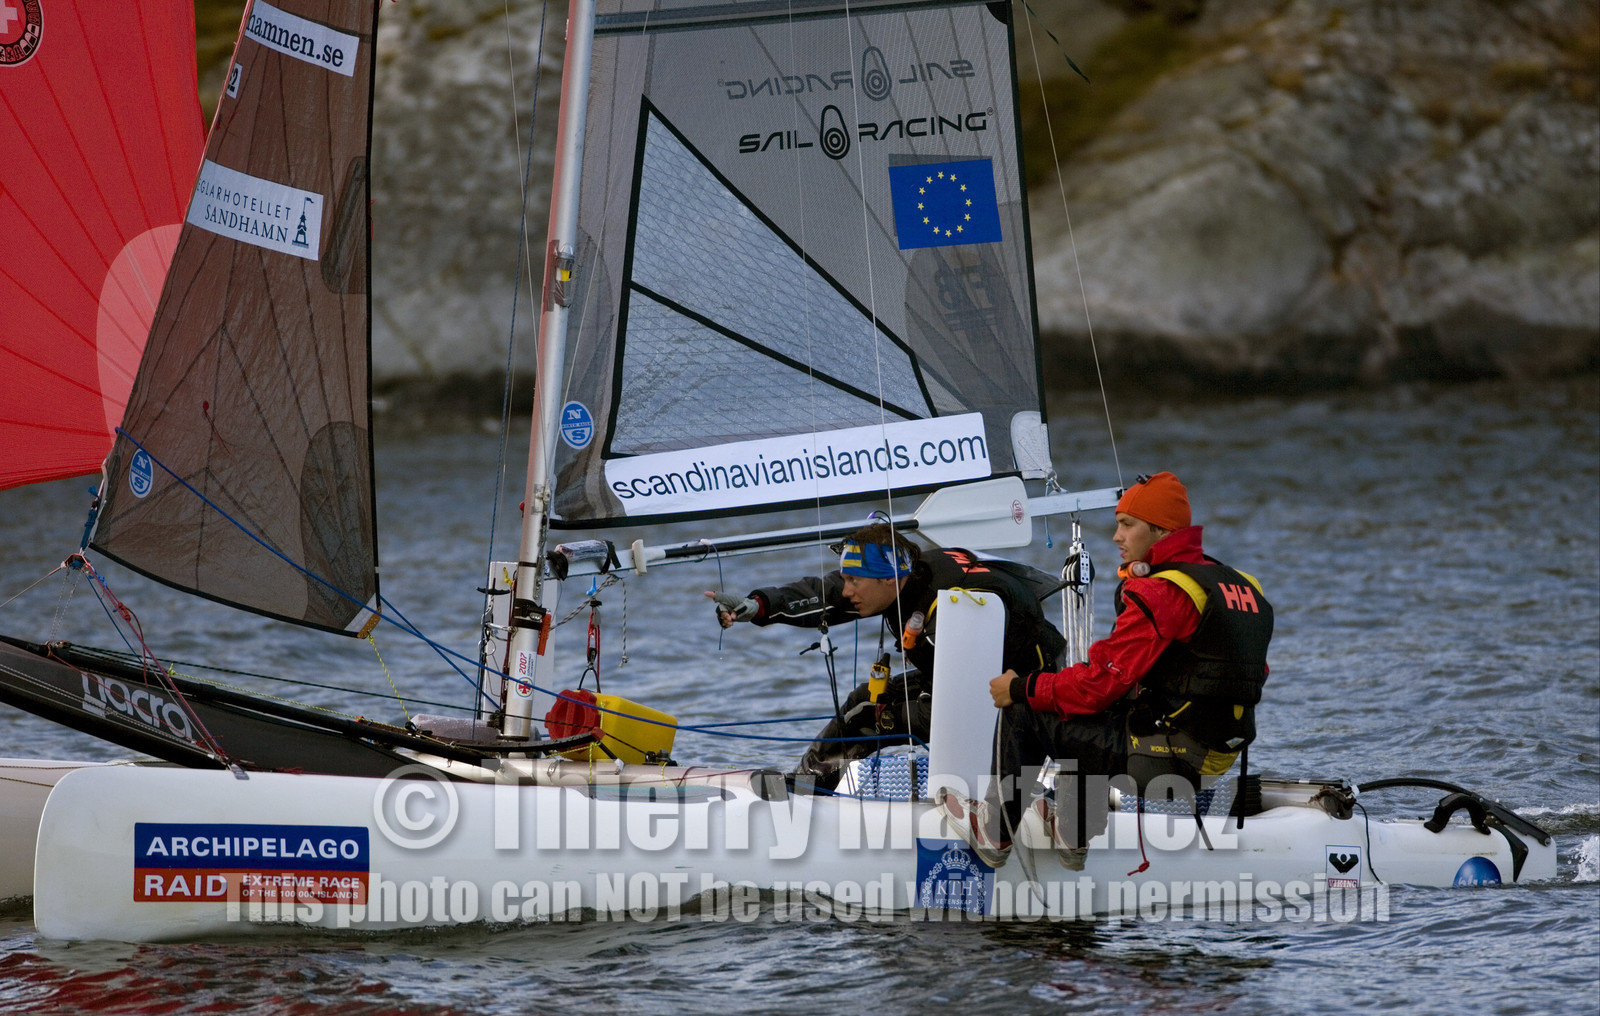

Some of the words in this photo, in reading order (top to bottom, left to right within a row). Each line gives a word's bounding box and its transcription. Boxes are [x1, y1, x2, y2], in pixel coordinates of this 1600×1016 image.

[739, 130, 814, 154] SAIL
[204, 203, 289, 243] SANDHAMN
[611, 434, 989, 500] scandinavianislands.com
[1217, 582, 1260, 614] HH
[518, 652, 528, 675] 2007
[1150, 745, 1170, 754] WORLD
[146, 836, 360, 860] ARCHIPELAGO
[144, 874, 228, 898] RAID
[242, 874, 315, 888] EXTREME
[319, 876, 360, 889] RACE
[242, 888, 255, 897] OF
[258, 889, 276, 898] THE
[280, 889, 296, 898] 100
[298, 890, 315, 898] 000
[317, 890, 359, 899] ISLANDS
[936, 879, 973, 896] KTH
